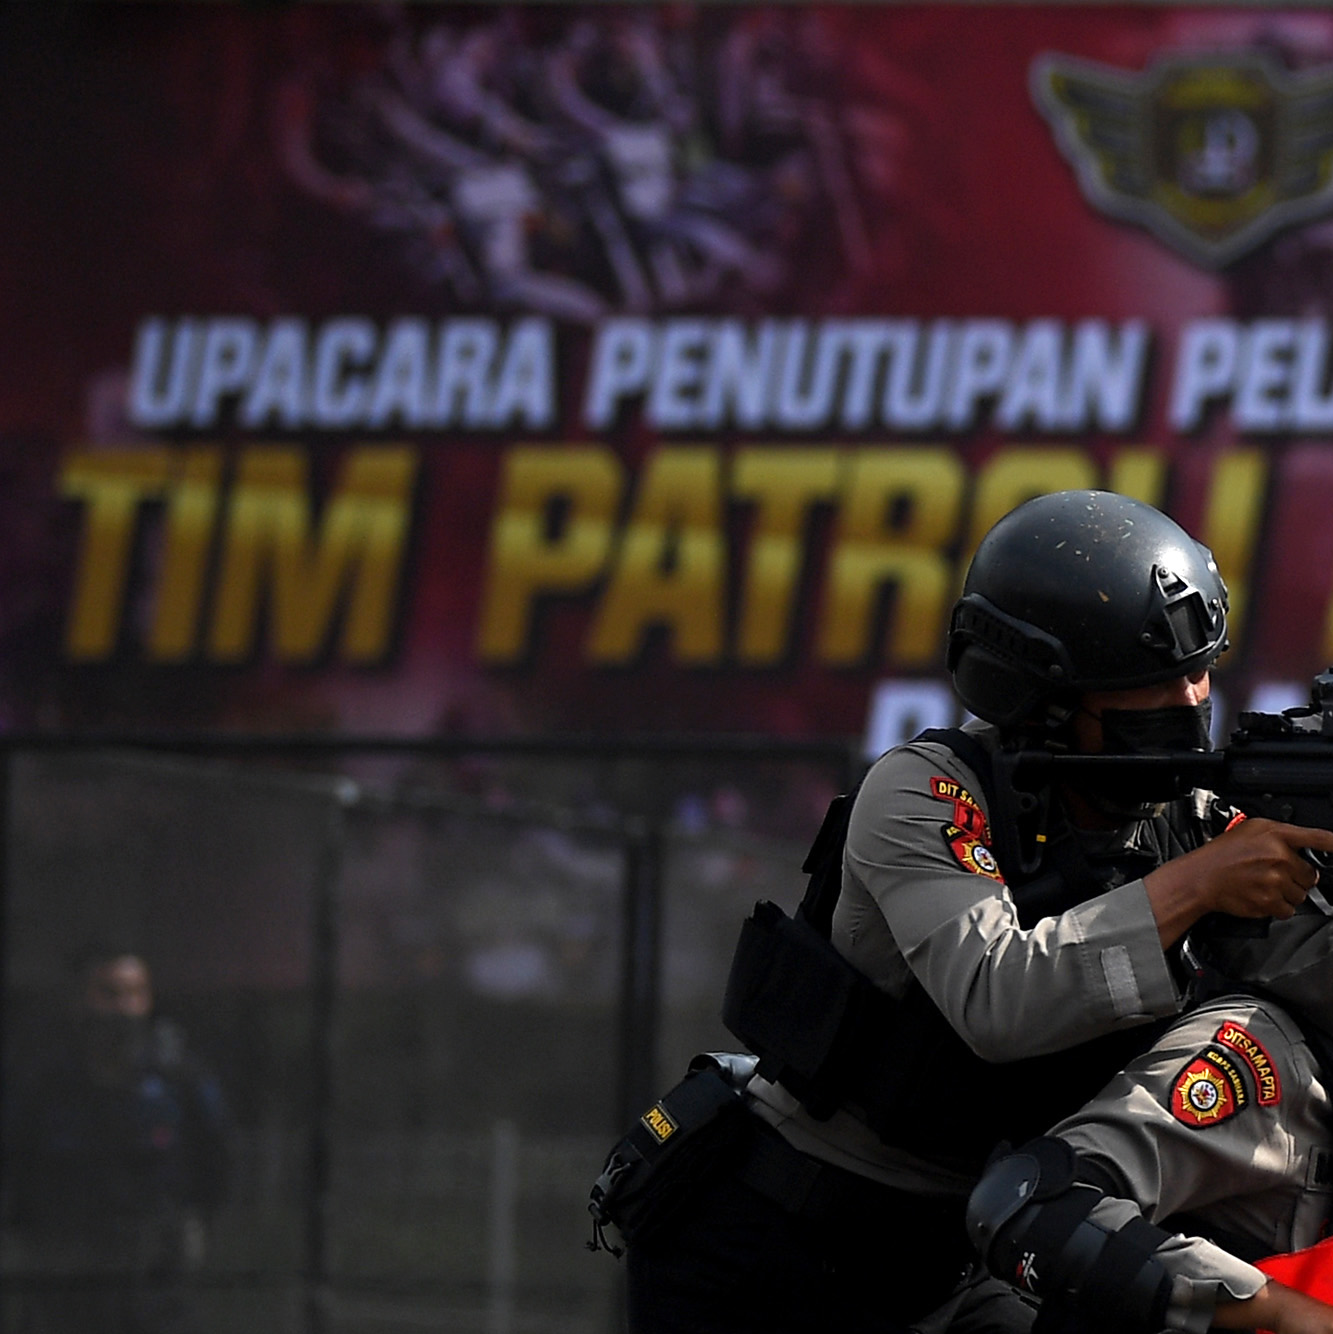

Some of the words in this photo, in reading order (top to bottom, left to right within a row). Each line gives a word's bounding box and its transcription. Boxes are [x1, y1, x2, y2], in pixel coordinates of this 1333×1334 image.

[132, 317, 556, 429] UPACARA
[590, 317, 1153, 431] PENUTUPAN
[58, 446, 418, 664] TIM
[938, 781, 959, 797] DIT
